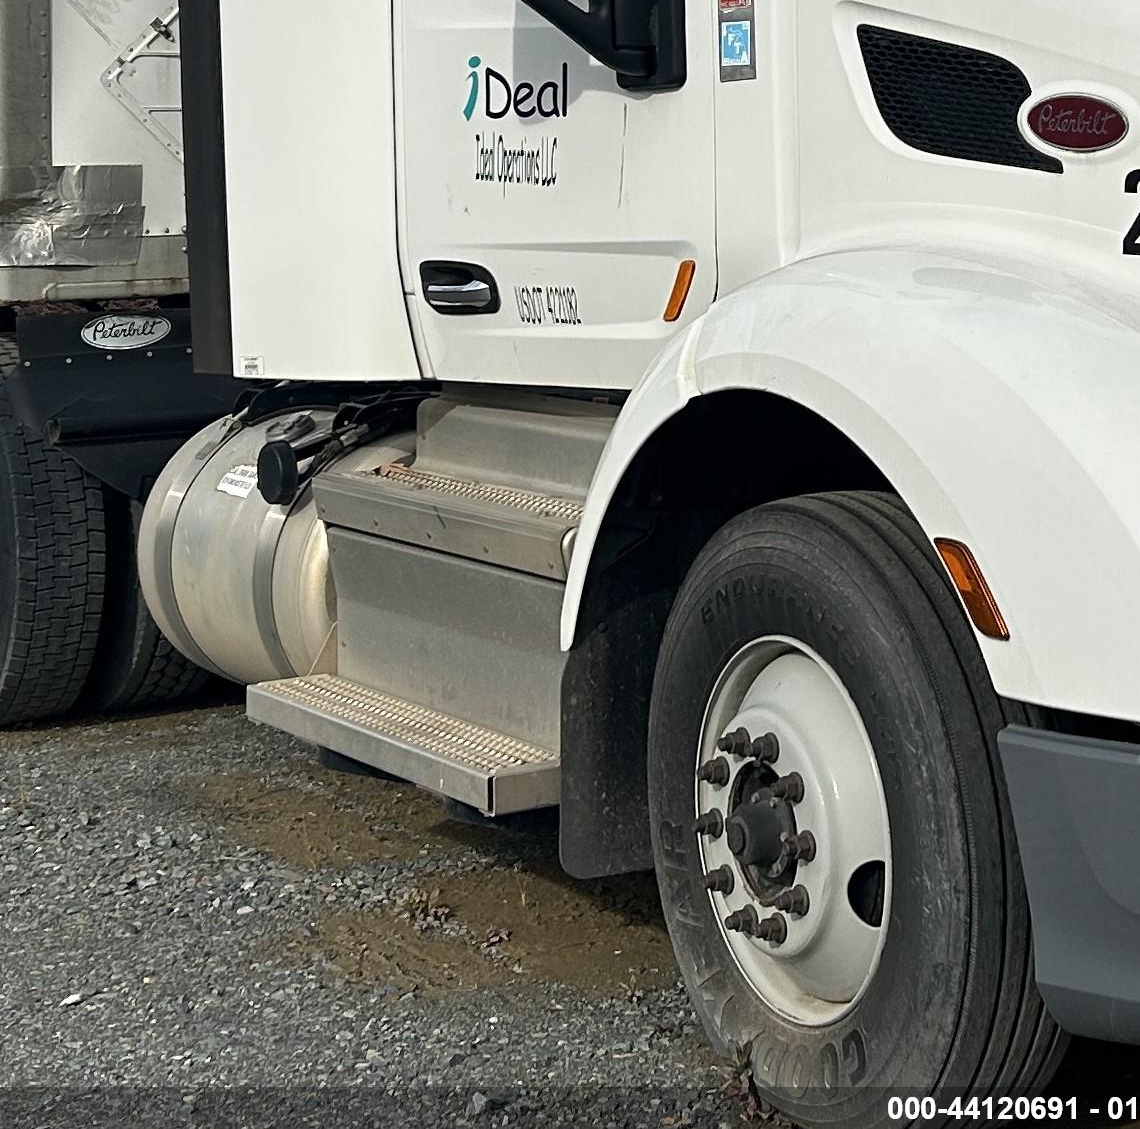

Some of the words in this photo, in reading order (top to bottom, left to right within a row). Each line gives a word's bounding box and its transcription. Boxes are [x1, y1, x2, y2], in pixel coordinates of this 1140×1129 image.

[463, 55, 568, 121] iDeal
[1037, 104, 1117, 135] Peterbilt
[475, 131, 496, 182] Ideal
[541, 135, 558, 187] LLC
[513, 284, 546, 325] USDOT
[92, 321, 163, 342] Peterbilt
